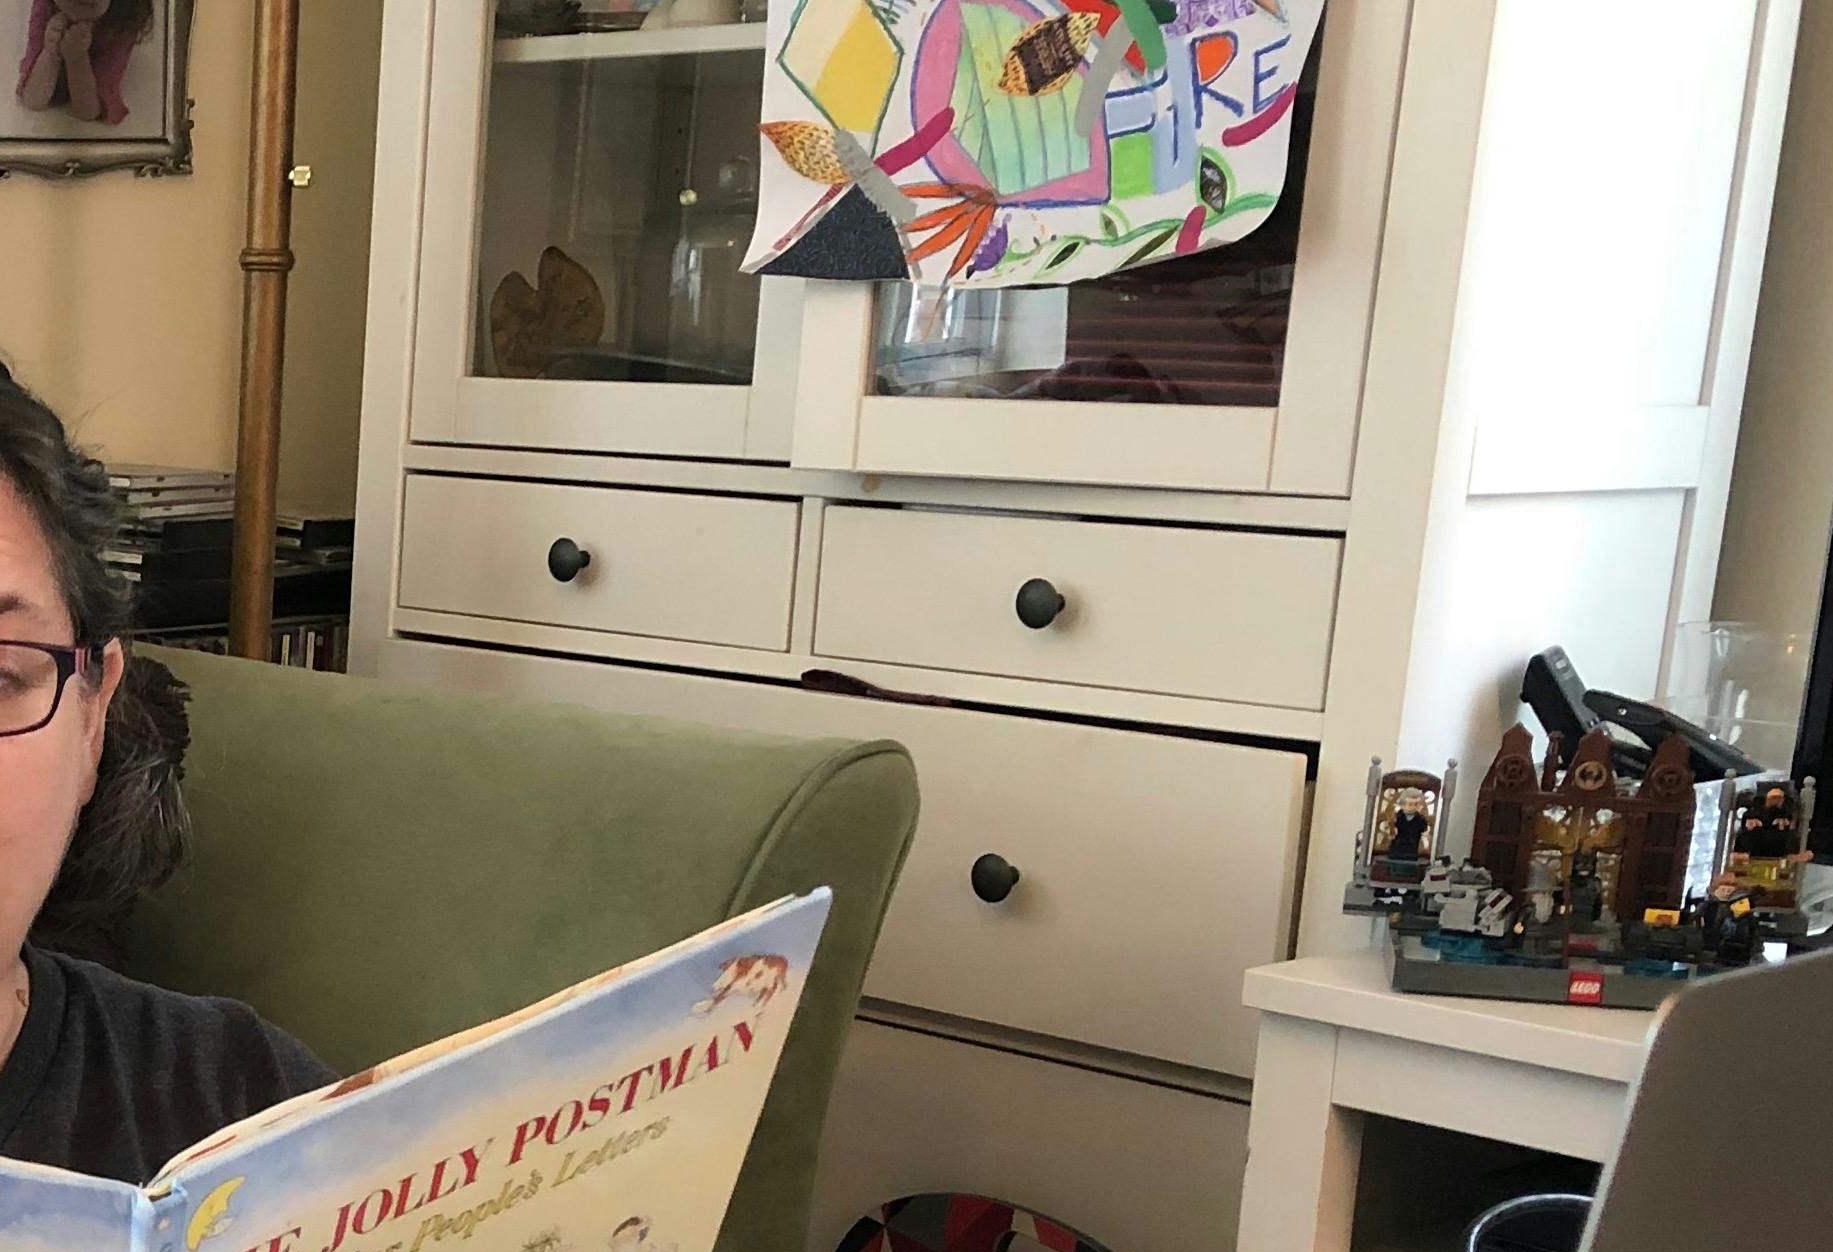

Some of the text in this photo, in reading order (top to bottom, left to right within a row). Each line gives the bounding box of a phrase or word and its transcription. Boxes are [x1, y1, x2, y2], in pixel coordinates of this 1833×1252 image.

[1569, 980, 1601, 995] LEGO
[506, 1012, 765, 1167] POSTMAN
[552, 1115, 674, 1188] Letters
